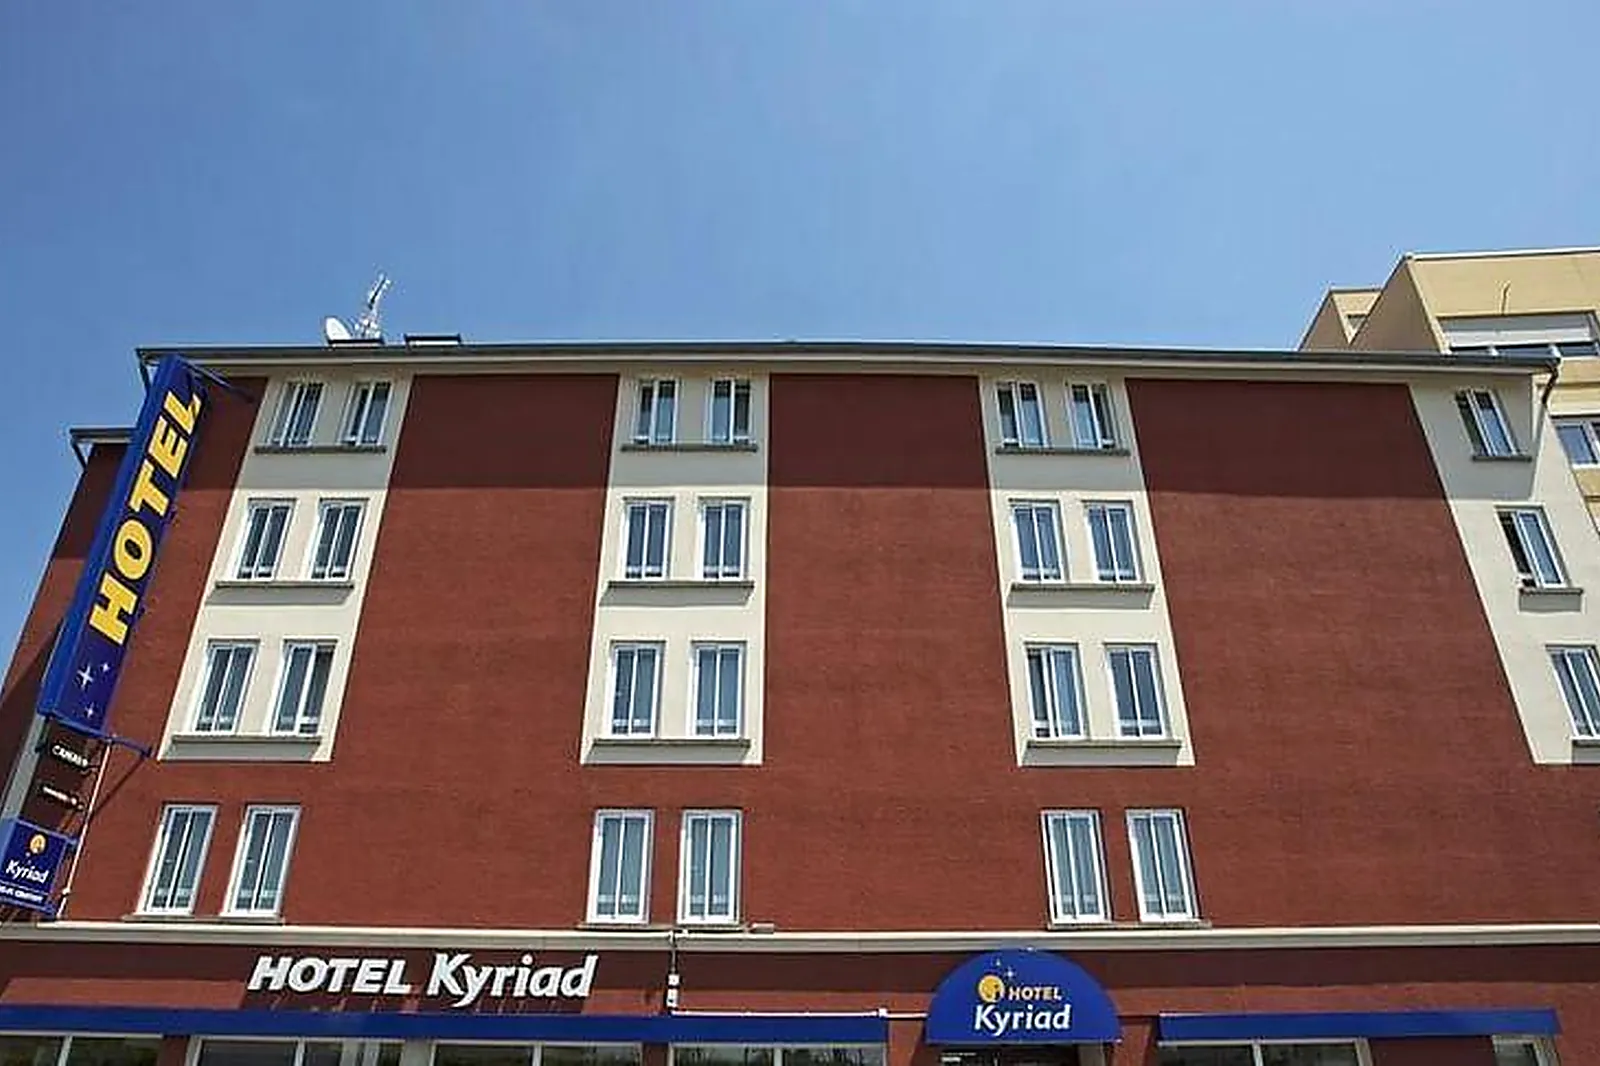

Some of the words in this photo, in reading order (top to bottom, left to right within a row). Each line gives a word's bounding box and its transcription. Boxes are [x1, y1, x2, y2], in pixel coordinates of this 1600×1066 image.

[89, 390, 202, 645] HOTEL
[5, 859, 50, 883] Kyriad
[247, 955, 411, 995] HOTEL
[427, 952, 599, 1009] Kyriad
[1008, 986, 1063, 1002] HOTEL
[974, 1003, 1071, 1037] Kyriad
